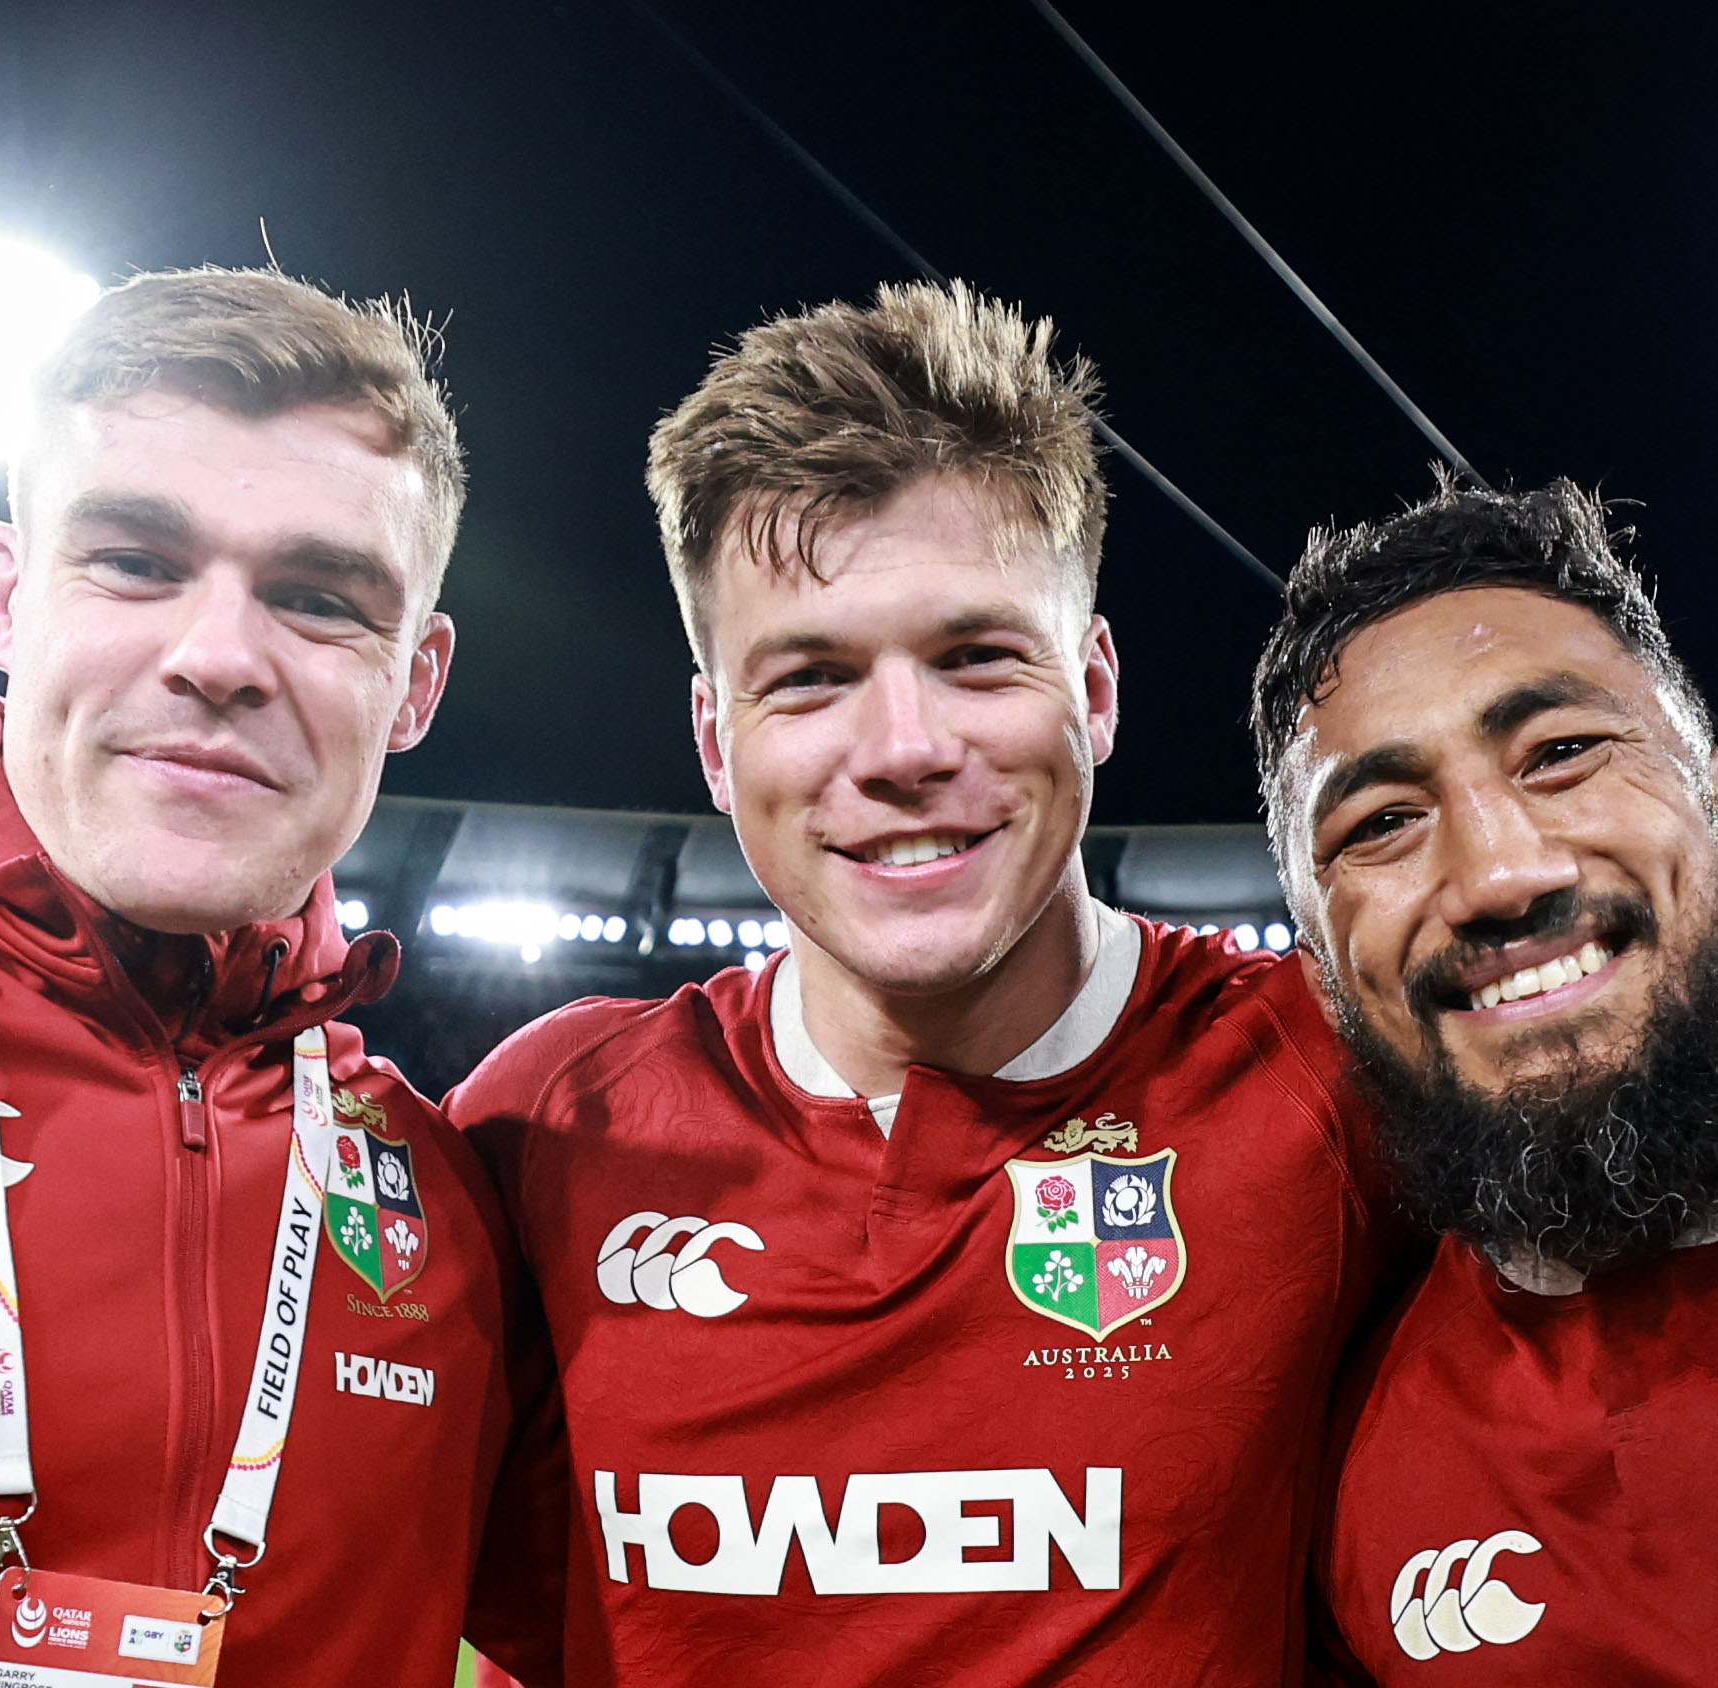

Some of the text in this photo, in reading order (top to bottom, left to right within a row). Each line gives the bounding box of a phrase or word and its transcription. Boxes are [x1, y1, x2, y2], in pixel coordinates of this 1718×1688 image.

[257, 1200, 314, 1421] FIELD OF PLAY
[347, 1293, 429, 1322] SINCE 1888
[1023, 1343, 1173, 1366] AUSTRALIA
[334, 1351, 435, 1407] HOWDEN
[1065, 1365, 1131, 1380] 2025
[3, 1380, 15, 1416] QATAR
[593, 1466, 1123, 1596] HOWDEN
[52, 1607, 92, 1622] QATAR
[49, 1626, 90, 1642] LIONS
